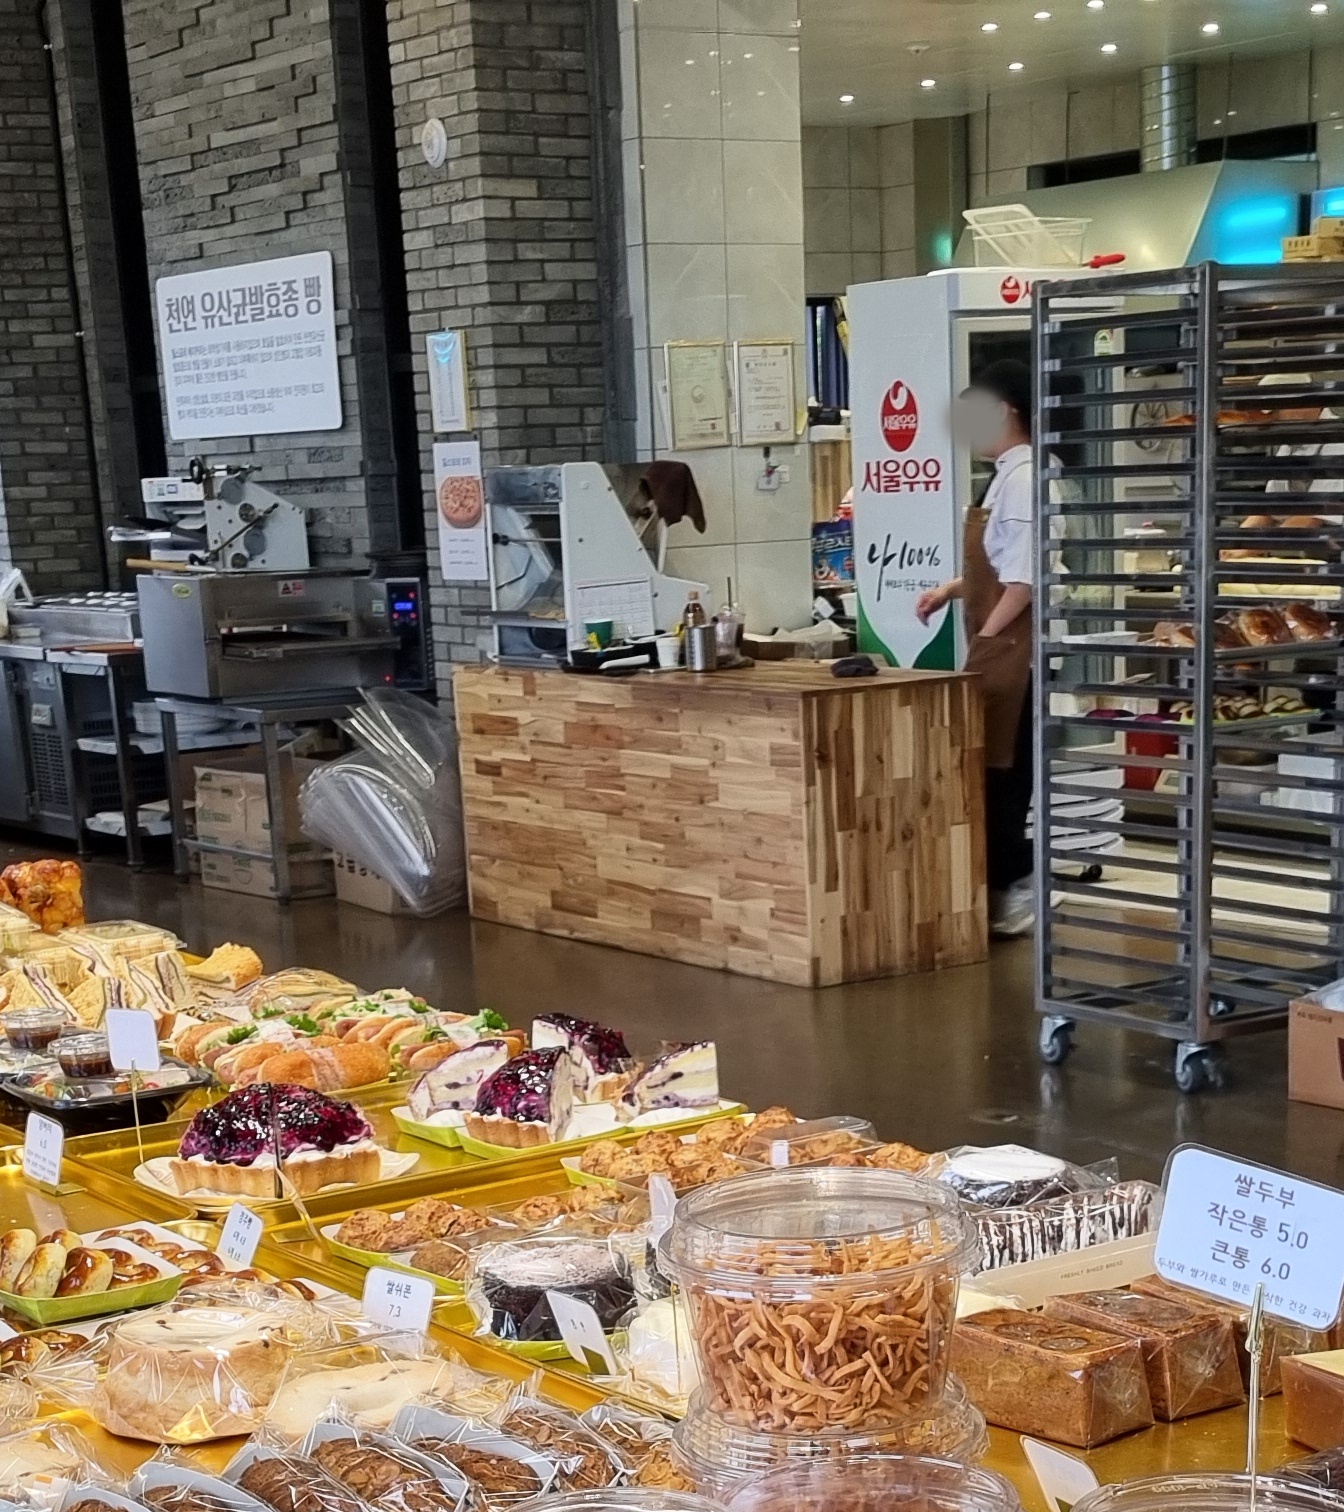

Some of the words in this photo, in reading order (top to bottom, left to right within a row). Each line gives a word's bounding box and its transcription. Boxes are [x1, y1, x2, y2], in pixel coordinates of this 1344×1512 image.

[164, 294, 198, 334] 천연
[200, 278, 300, 331] 유산균발효종
[303, 275, 323, 316] 빵
[861, 457, 943, 494] 서울우유
[1234, 1172, 1296, 1210] 쌀두부
[1207, 1201, 1269, 1239] 작은통
[1276, 1221, 1309, 1250] 5.0
[1210, 1238, 1251, 1270] 큰통
[1260, 1256, 1291, 1281] 6.0
[386, 1279, 412, 1300] 쌀쉬폰
[1157, 1256, 1186, 1274] 두부와
[1190, 1266, 1227, 1288] 쌀가루로
[1232, 1281, 1251, 1296] 만든
[1260, 1289, 1284, 1306] 삭한
[1288, 1299, 1308, 1315] 건강
[1312, 1307, 1332, 1323] 과자
[388, 1303, 402, 1318] 7.3
